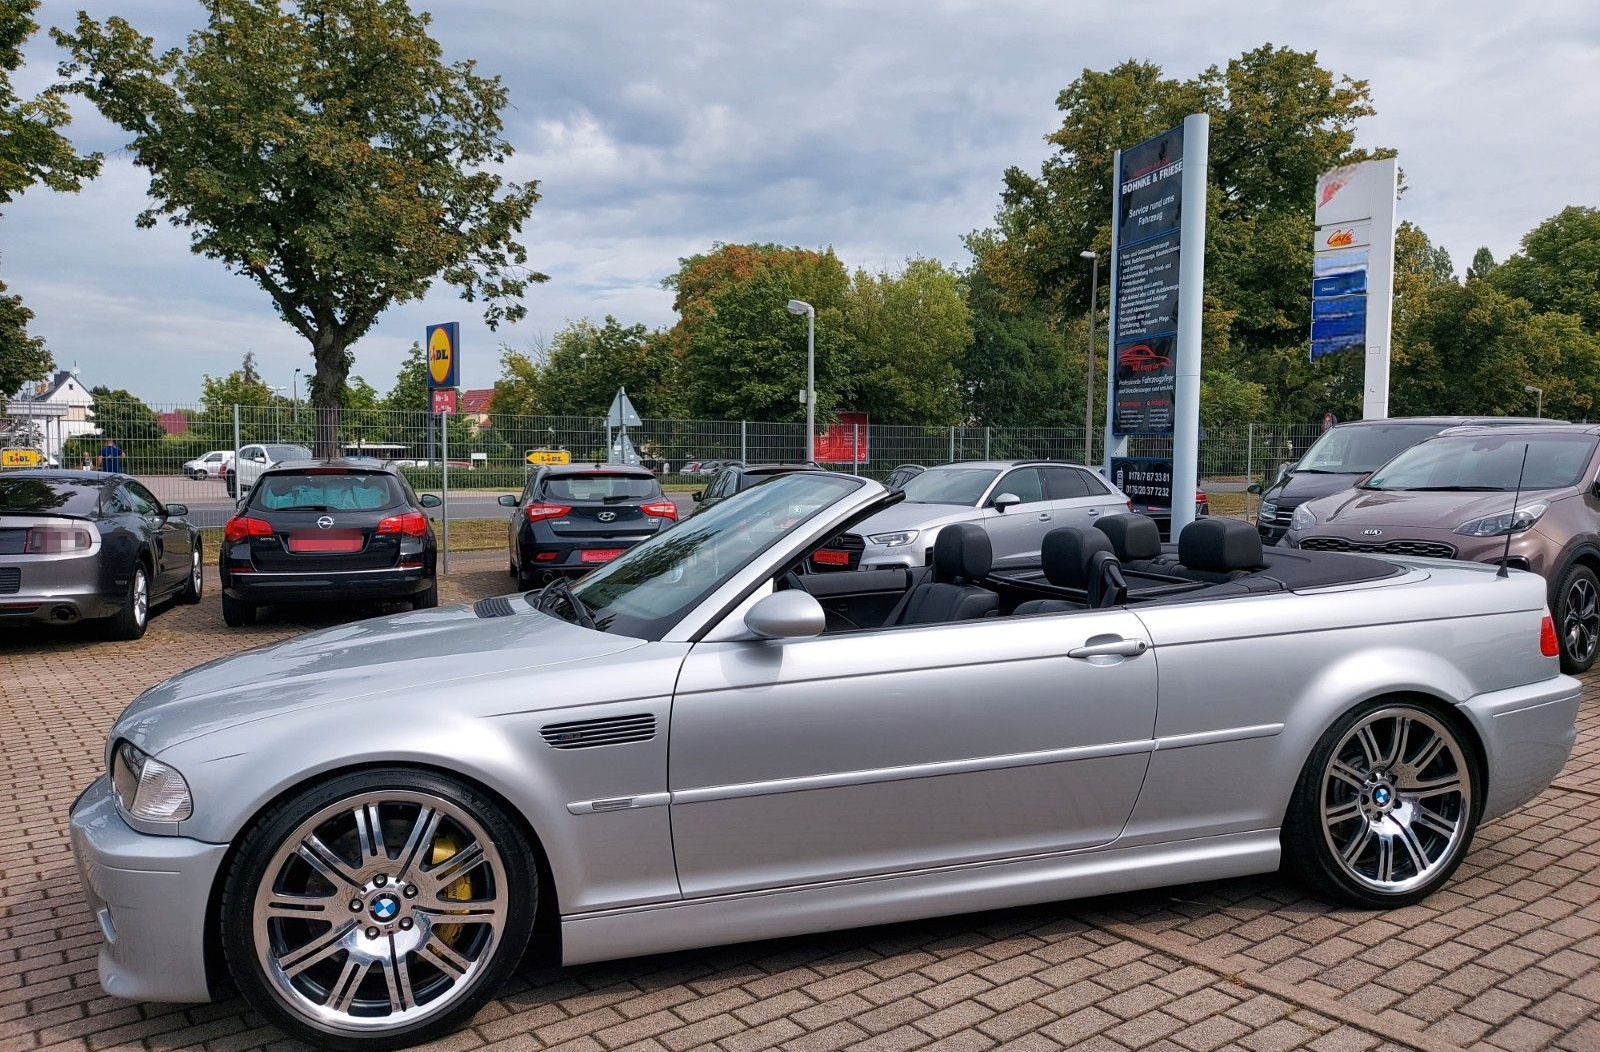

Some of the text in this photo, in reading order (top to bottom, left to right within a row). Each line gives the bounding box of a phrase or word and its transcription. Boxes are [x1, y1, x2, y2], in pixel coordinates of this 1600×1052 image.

[1153, 172, 1158, 183] &
[1159, 161, 1183, 181] FRIESE
[1129, 195, 1175, 218] Service rund ums
[1138, 211, 1163, 226] Fahrzeug
